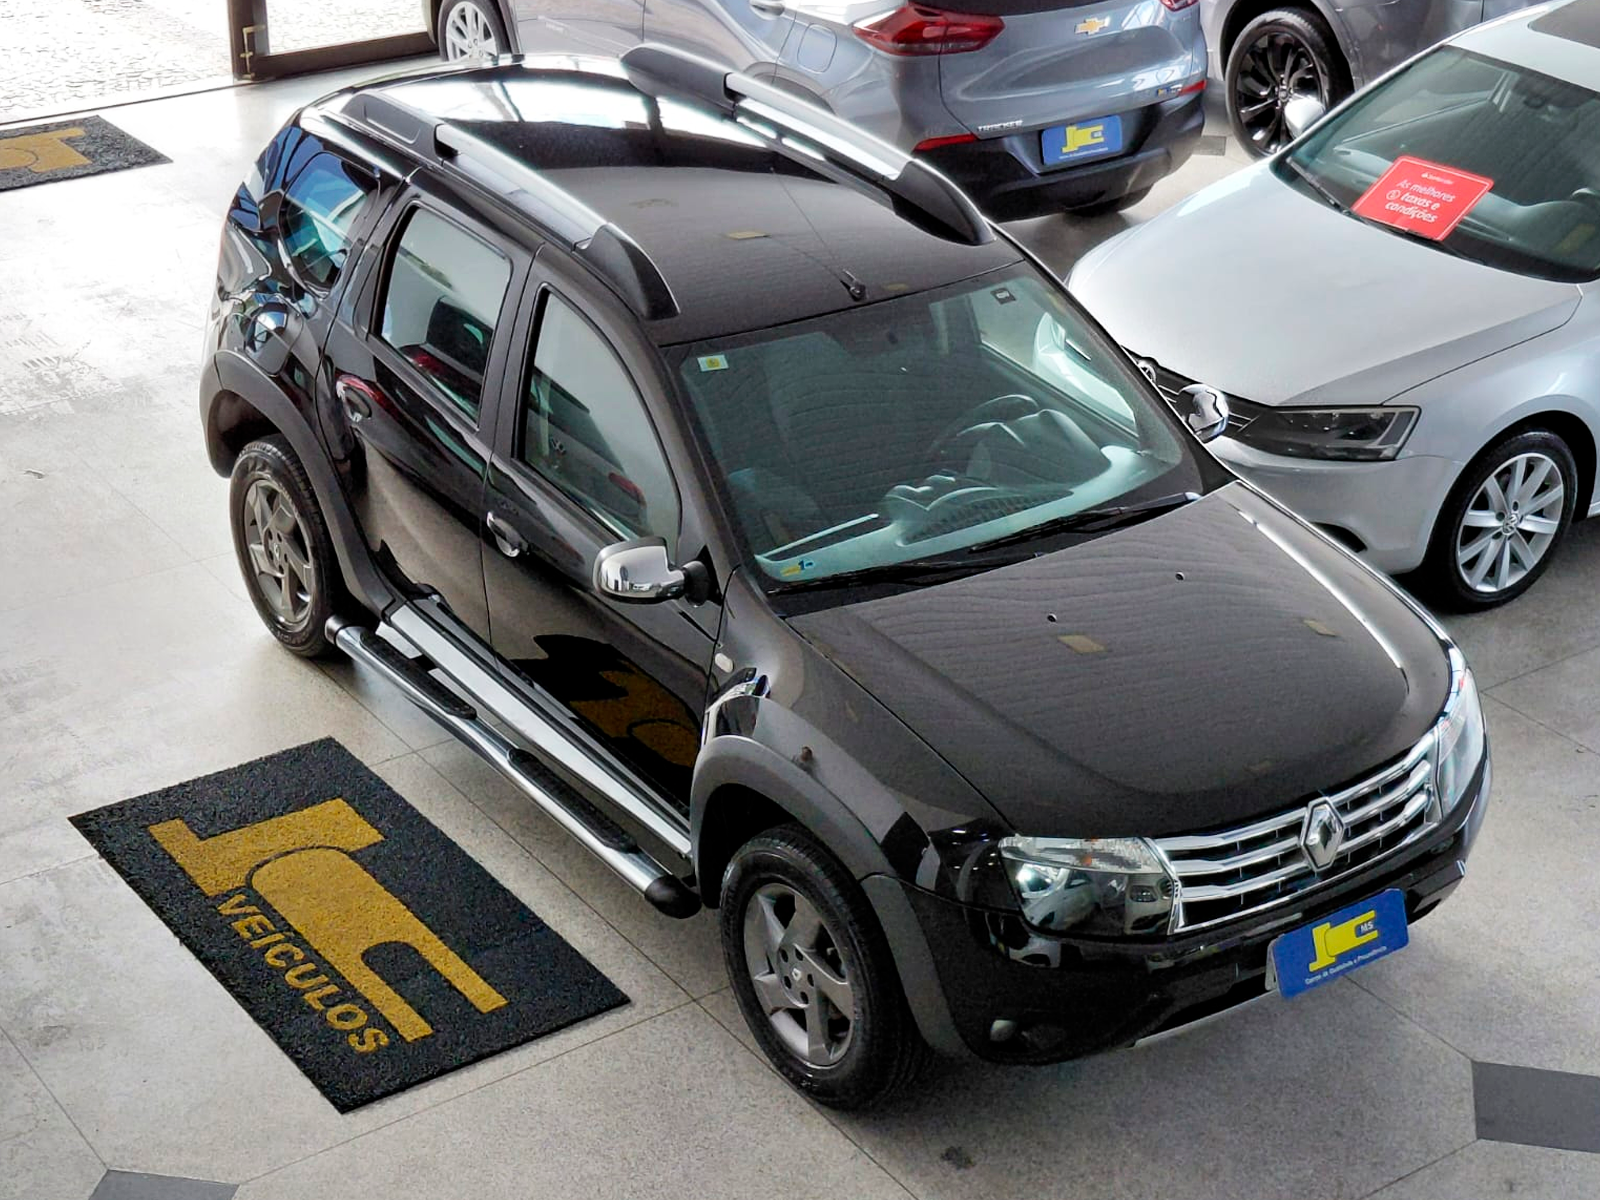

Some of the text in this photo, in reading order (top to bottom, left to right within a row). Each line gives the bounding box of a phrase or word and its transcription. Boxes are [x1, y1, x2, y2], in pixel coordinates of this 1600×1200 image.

[1396, 179, 1456, 203] As melhores
[1400, 192, 1441, 211] taxas e
[1385, 201, 1438, 223] condições
[1360, 921, 1375, 933] MS
